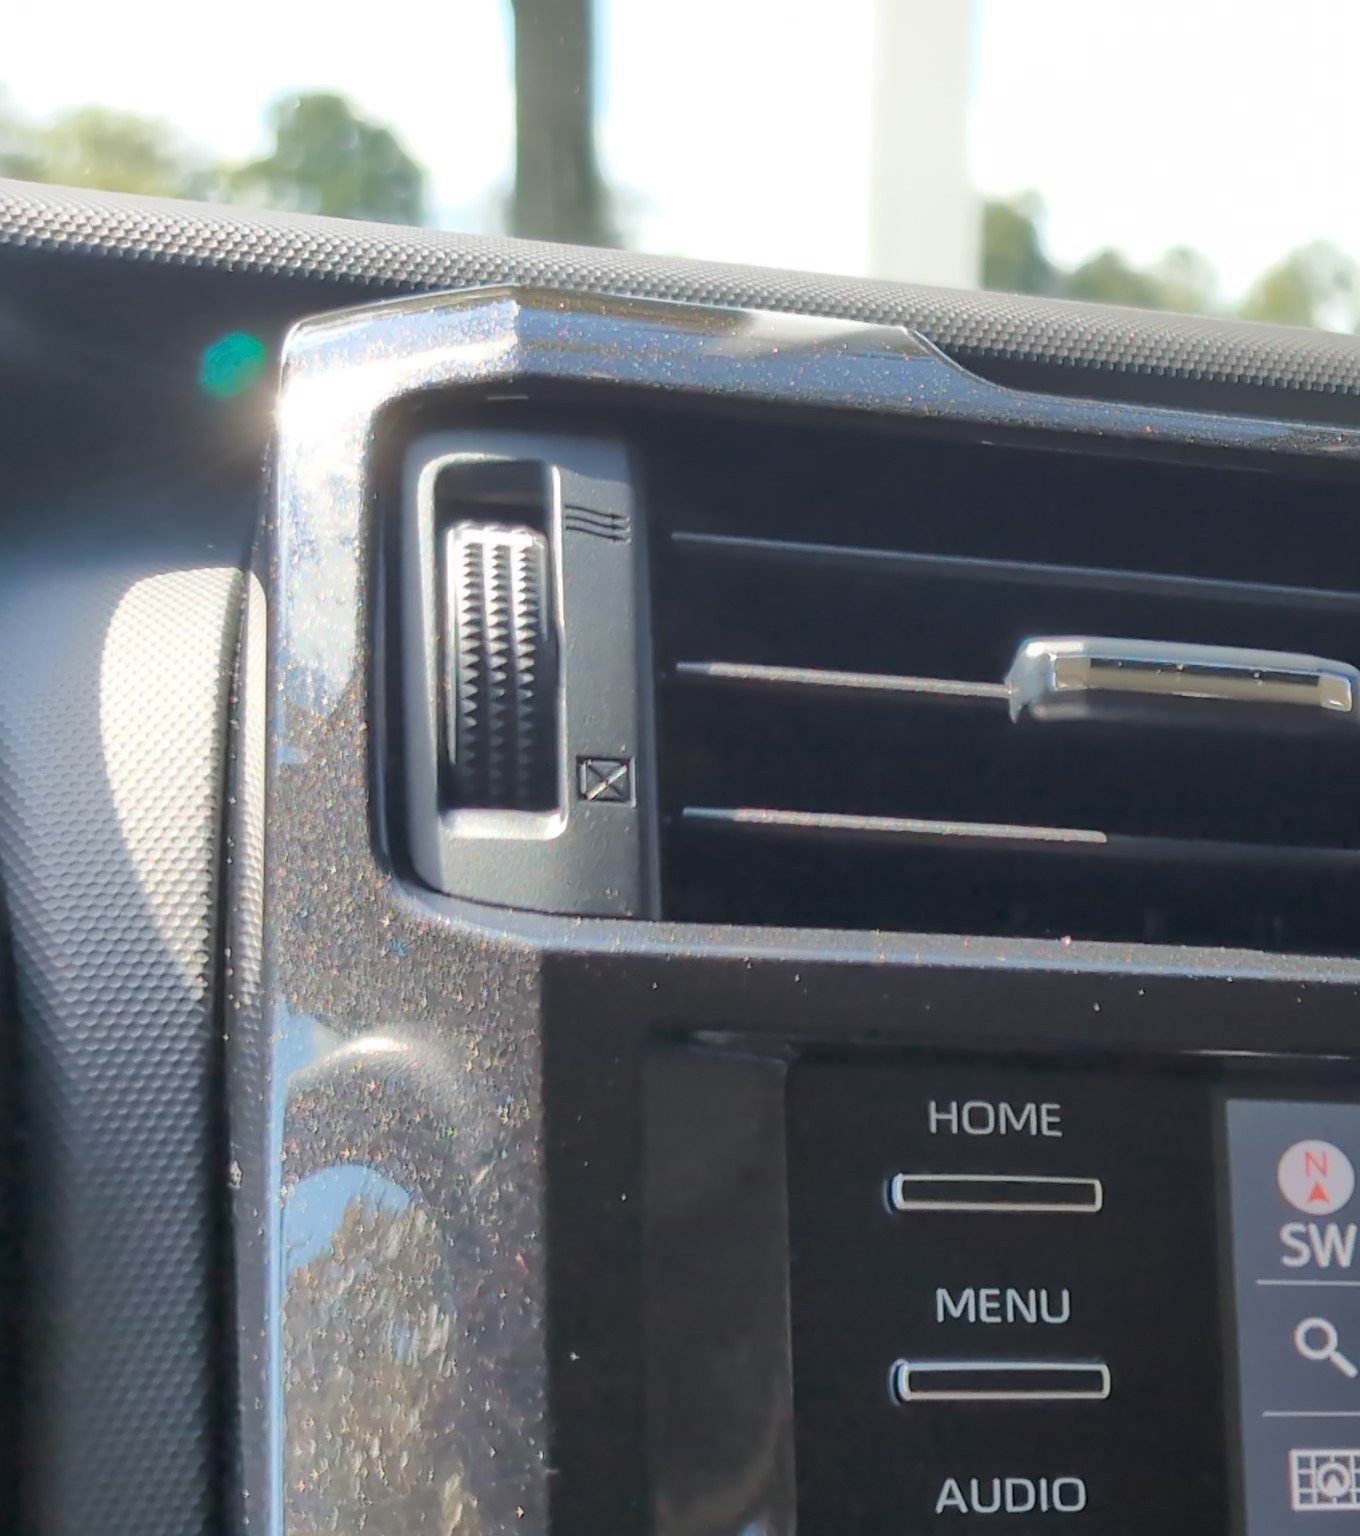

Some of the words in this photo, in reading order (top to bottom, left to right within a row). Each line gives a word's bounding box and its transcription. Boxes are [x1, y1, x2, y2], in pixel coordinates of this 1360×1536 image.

[927, 1100, 1064, 1138] HOME
[1305, 1150, 1329, 1179] N
[1279, 1223, 1359, 1269] SW
[935, 1286, 1072, 1325] MENU
[934, 1475, 1088, 1515] AUDIO
